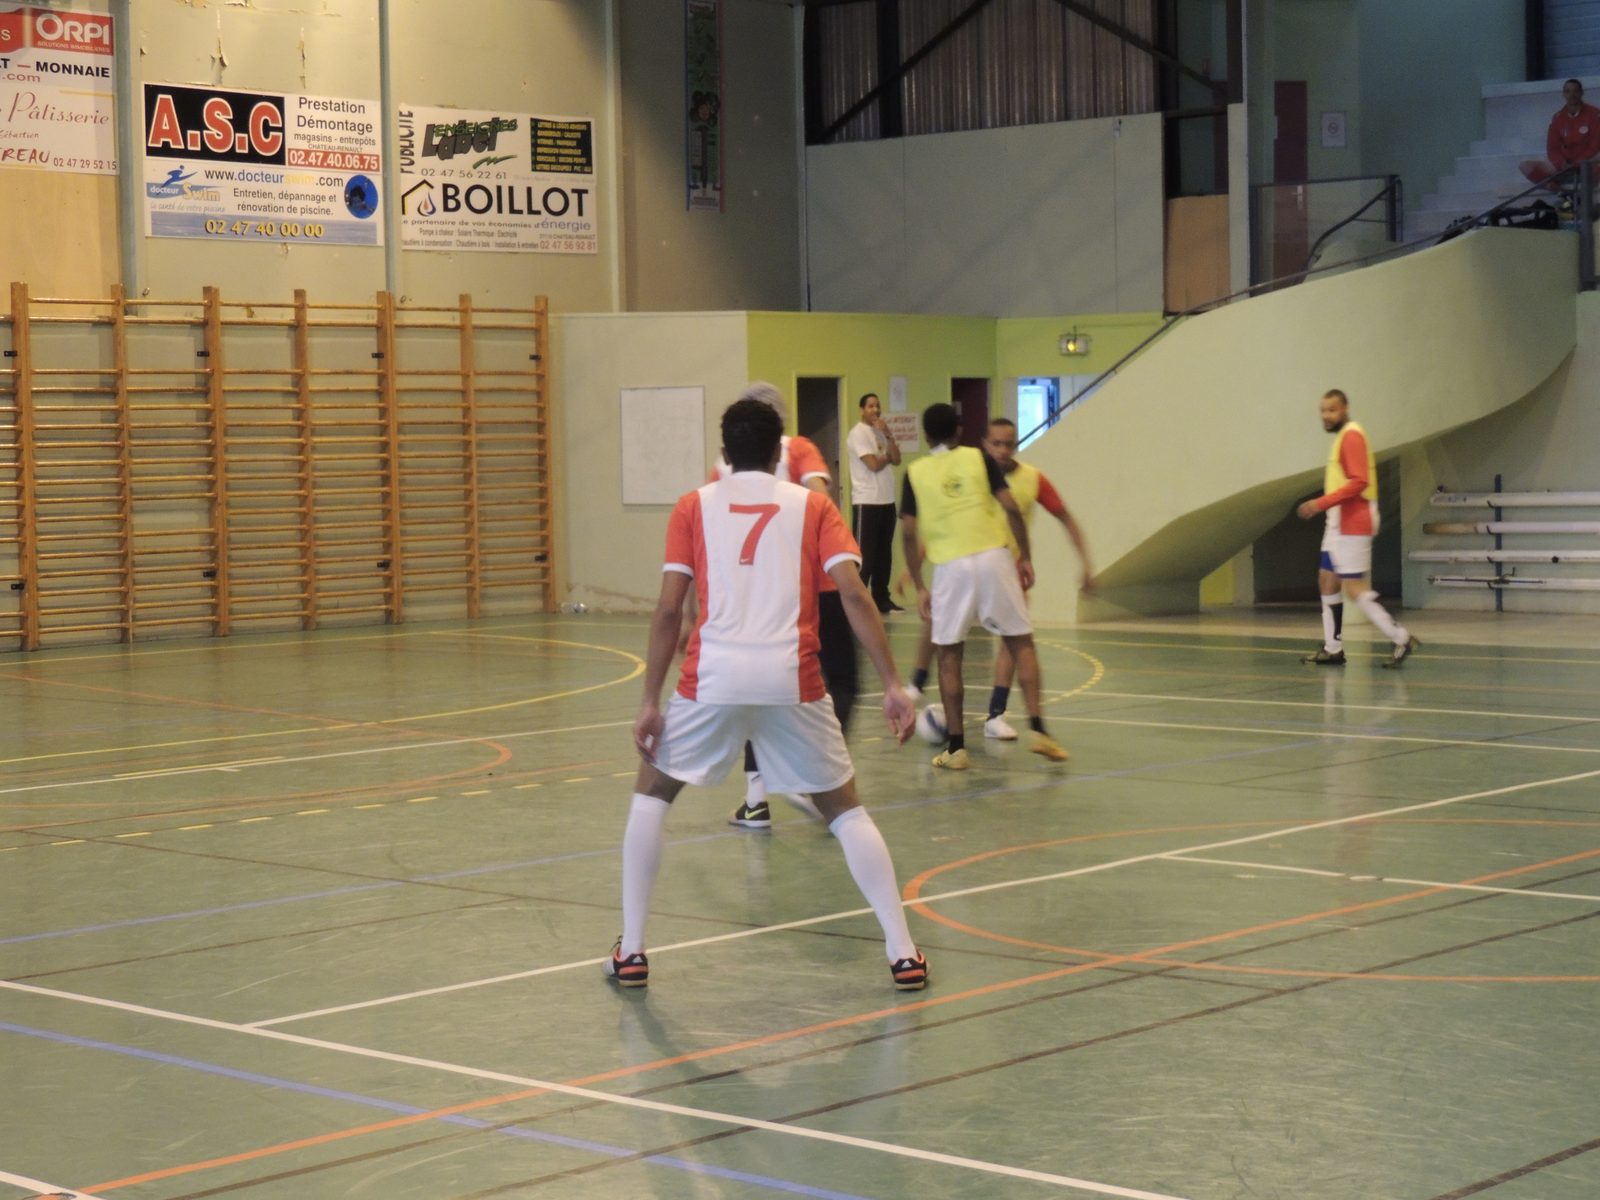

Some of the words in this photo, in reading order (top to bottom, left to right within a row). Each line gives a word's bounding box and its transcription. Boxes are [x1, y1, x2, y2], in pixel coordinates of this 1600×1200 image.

[36, 13, 110, 46] ORPI
[36, 61, 111, 78] MONNAIE
[8, 91, 110, 126] Pâtisserie
[298, 96, 366, 114] Prestation
[148, 94, 284, 156] A.S.C
[296, 115, 374, 136] Démontage
[293, 132, 333, 144] magasins
[339, 135, 377, 147] entrepôts
[0, 147, 51, 165] REAU
[53, 157, 64, 168] 02
[67, 158, 78, 168] 47
[80, 159, 91, 169] 29
[93, 160, 104, 170] 52
[107, 160, 118, 170] 15
[289, 150, 379, 170] 02.47.40.06.75
[421, 168, 435, 177] 02
[440, 169, 454, 178] 47
[459, 170, 473, 179] 56
[478, 171, 491, 180] 22
[495, 171, 507, 180] 61
[150, 185, 180, 195] docteur
[233, 187, 276, 201] Entretien,
[278, 190, 327, 204] dépannage
[328, 194, 337, 203] et
[237, 201, 285, 214] rénovation
[286, 203, 299, 214] de
[300, 204, 334, 216] piscine.
[442, 183, 589, 217] BOILLOT
[205, 219, 226, 235] 02
[230, 220, 251, 236] 47
[255, 221, 276, 237] 40
[280, 222, 300, 238] 00
[304, 223, 325, 239] 00
[411, 219, 456, 227] partenaire
[729, 503, 781, 566] 7
